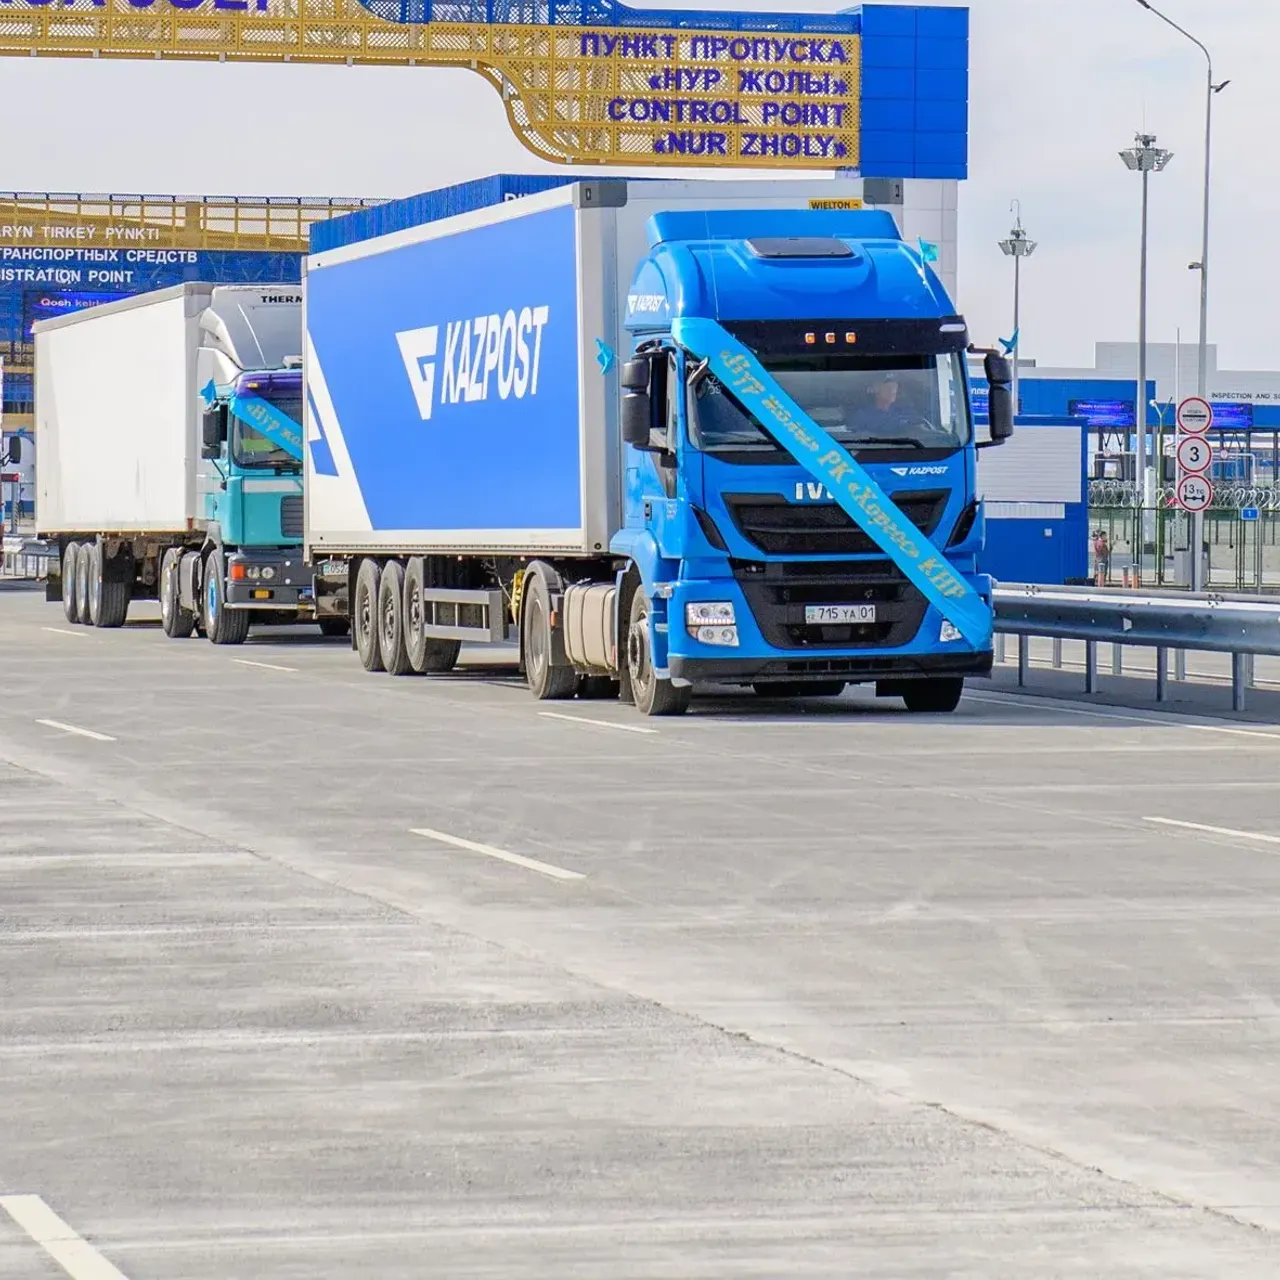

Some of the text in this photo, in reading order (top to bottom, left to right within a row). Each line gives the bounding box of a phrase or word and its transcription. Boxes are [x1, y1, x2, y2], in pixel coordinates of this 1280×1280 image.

[580, 33, 847, 64] ПУНКТ ПРОПУСКА
[648, 68, 848, 95] «НУР ЖОЛЫ»
[607, 98, 847, 126] CONTROL POINT
[653, 131, 847, 158] «NUR ZHOLY»
[811, 201, 851, 210] WIELTON
[126, 250, 198, 264] СРЕДСТВ
[88, 271, 134, 283] POINT
[441, 305, 549, 404] KAZPOST
[1189, 447, 1200, 462] 3
[909, 466, 949, 475] KAZPOST
[1183, 484, 1195, 494] 13
[818, 607, 839, 620] 715
[842, 610, 857, 620] YA
[860, 606, 874, 619] 01
